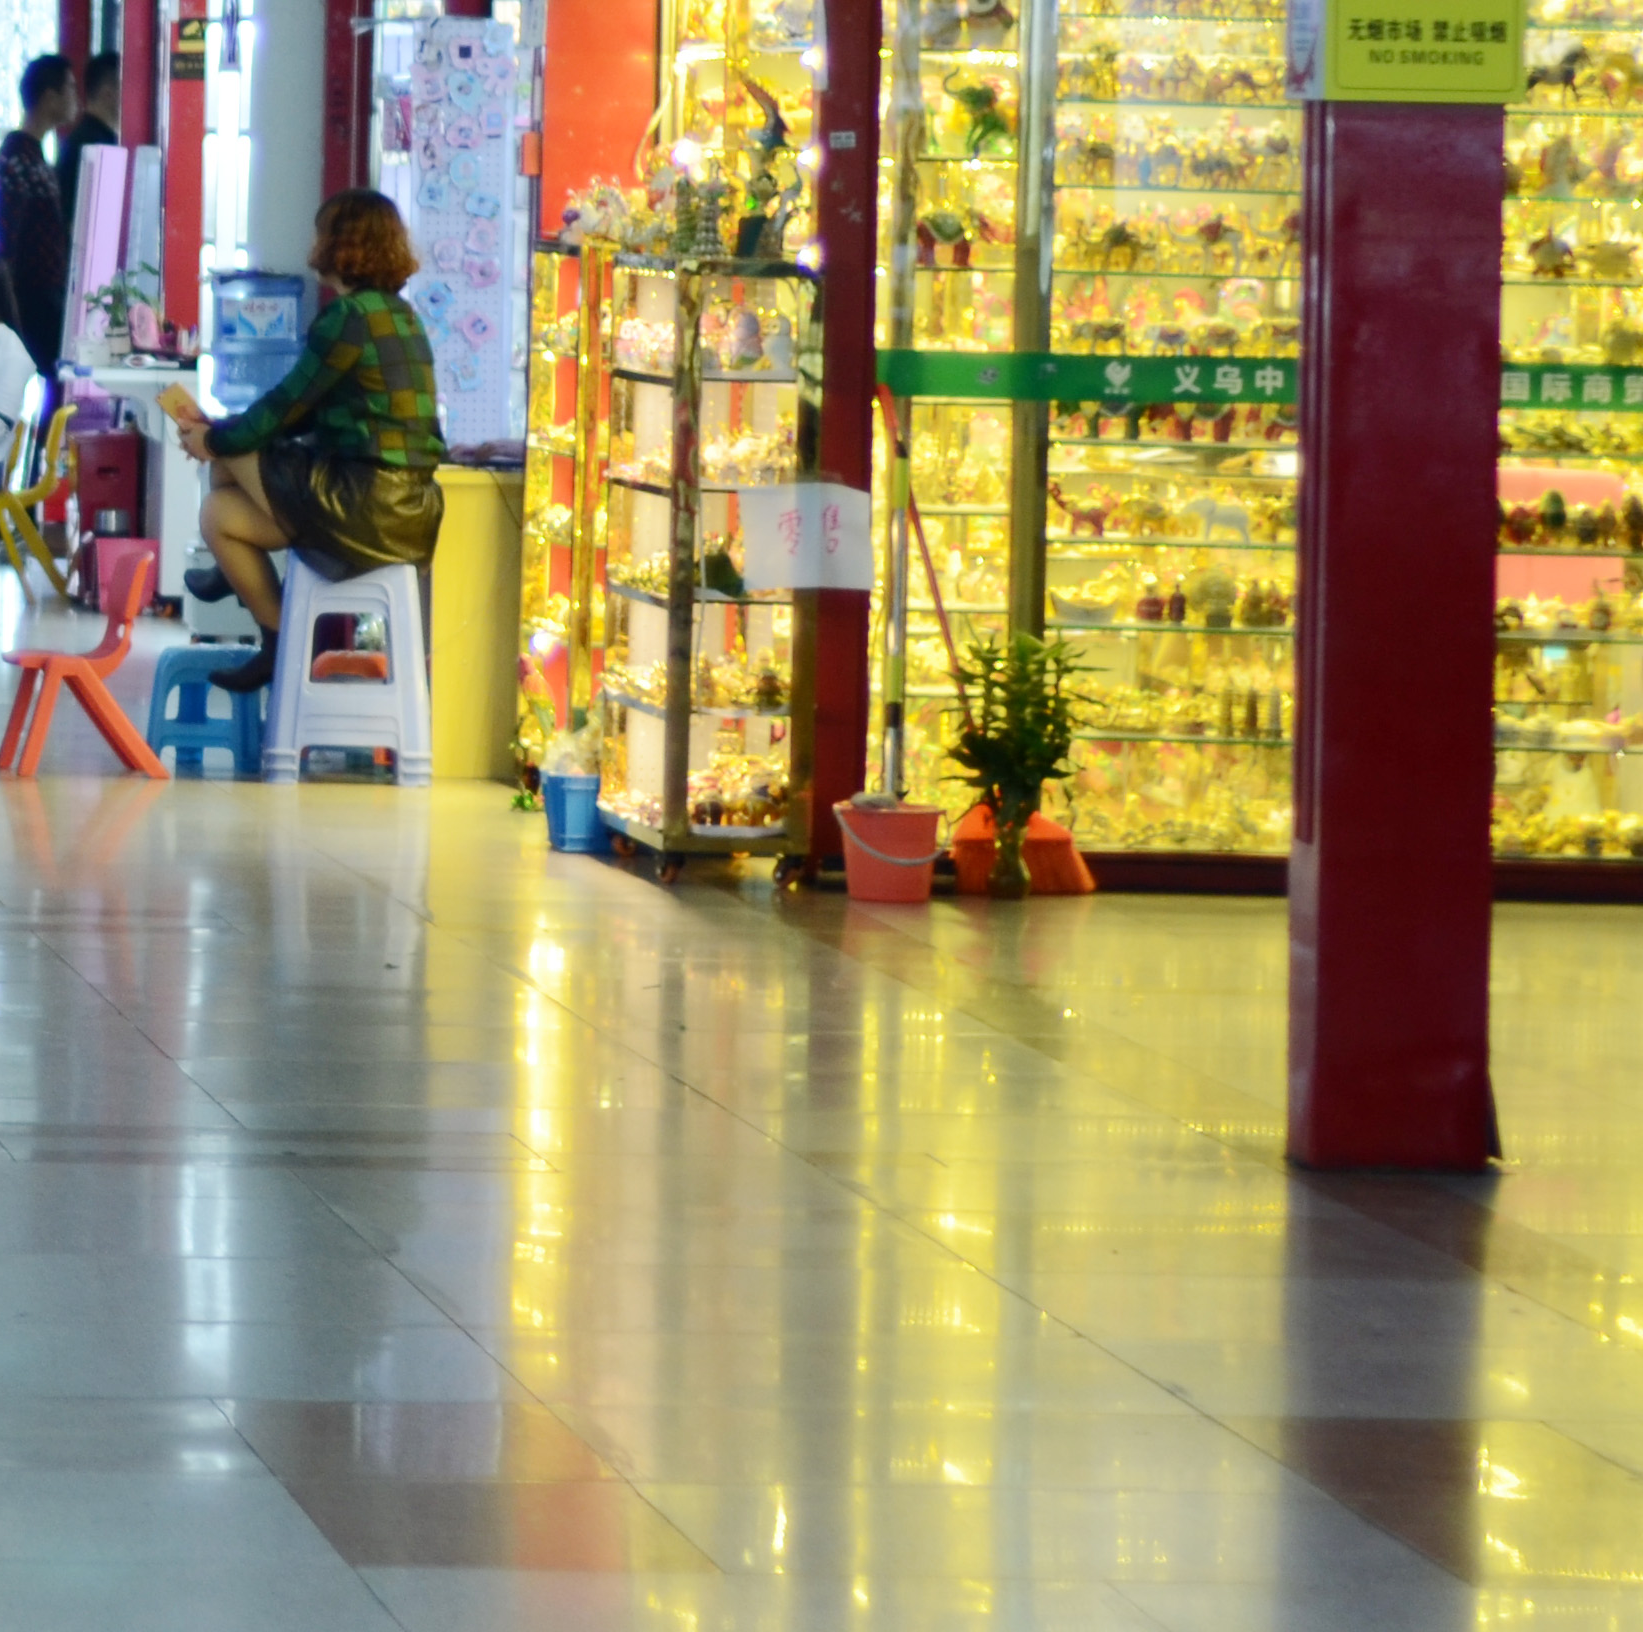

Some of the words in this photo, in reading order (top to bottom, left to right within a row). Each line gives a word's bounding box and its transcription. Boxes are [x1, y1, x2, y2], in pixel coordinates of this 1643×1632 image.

[1369, 49, 1396, 65] NO
[1400, 49, 1485, 66] SMOKING
[1172, 365, 1285, 396] 义乌中
